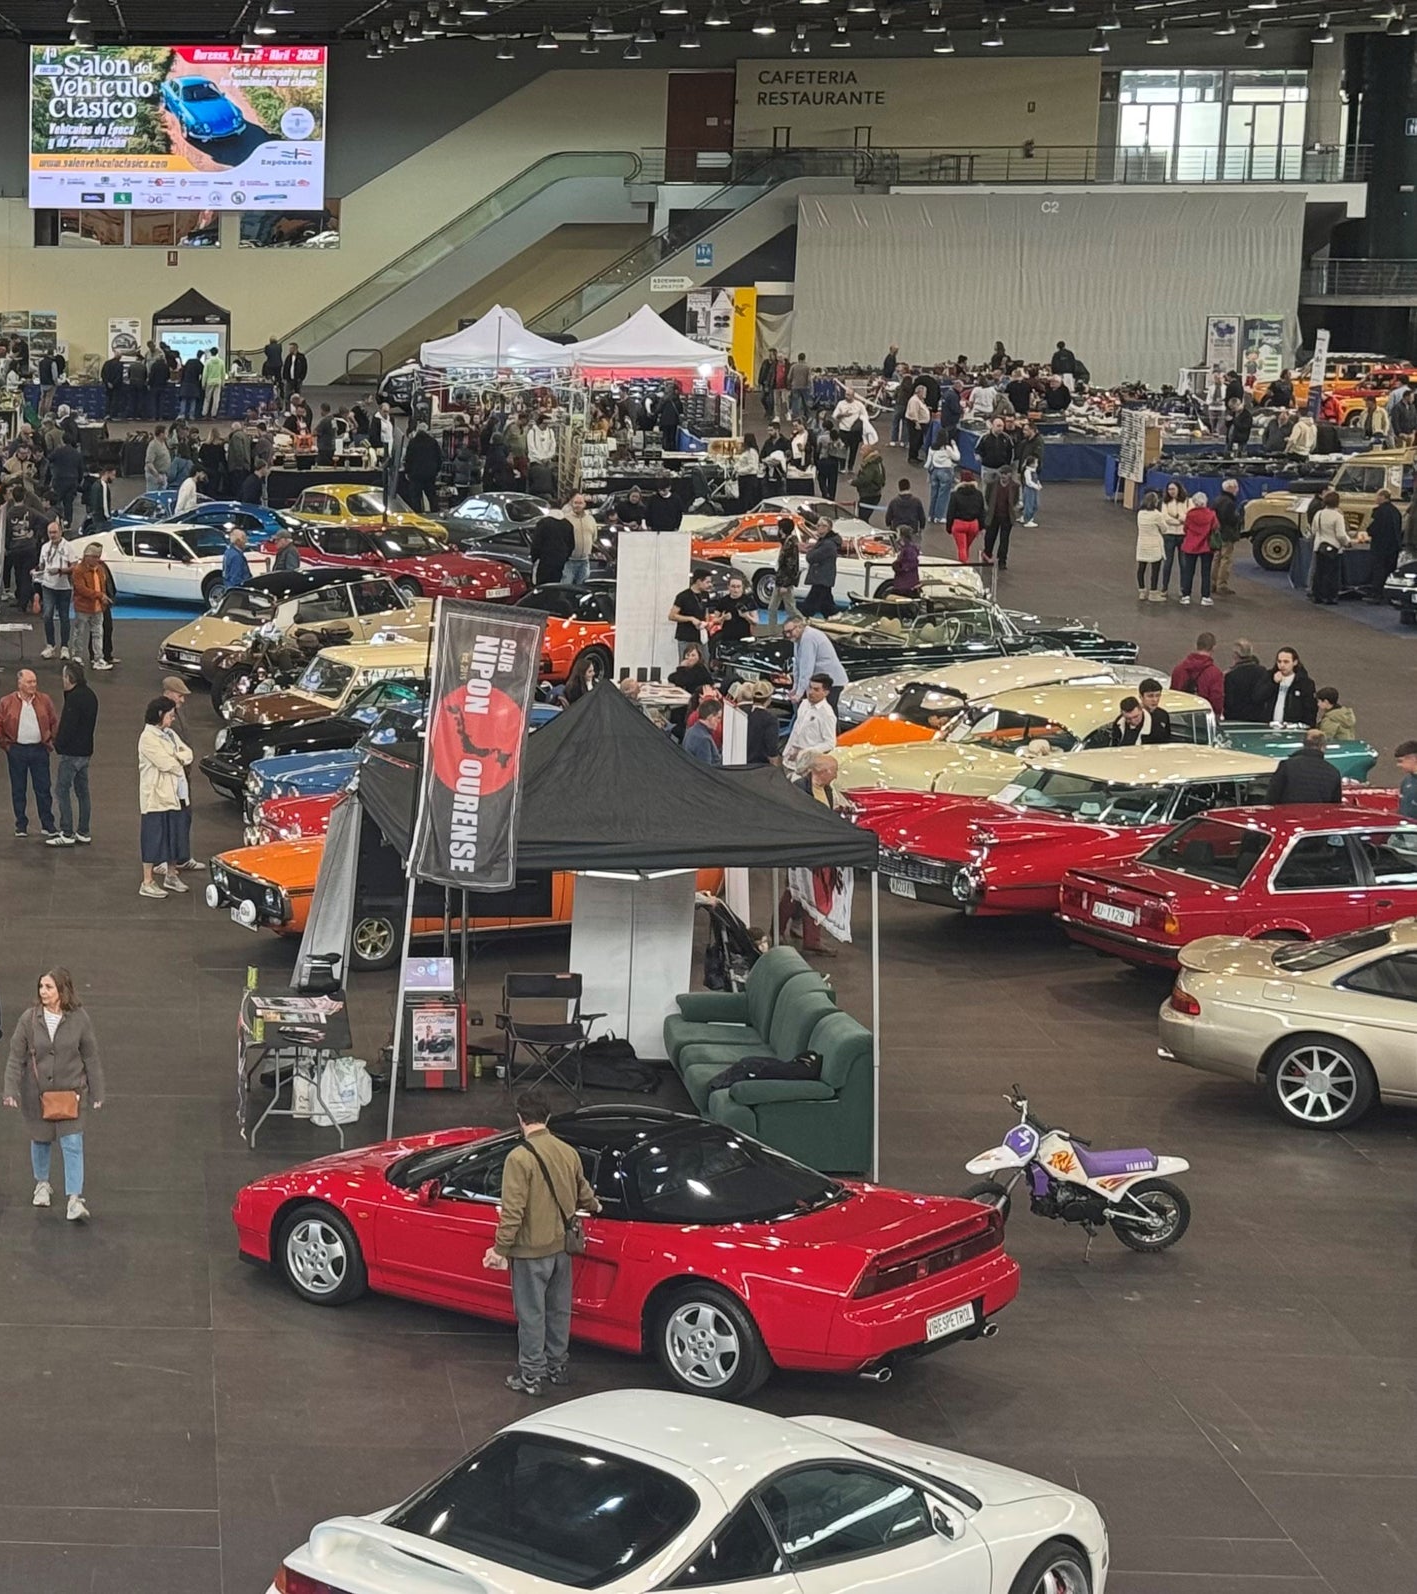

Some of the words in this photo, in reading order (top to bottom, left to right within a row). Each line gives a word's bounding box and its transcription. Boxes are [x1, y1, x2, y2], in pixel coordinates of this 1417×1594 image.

[64, 55, 131, 76] Salón
[134, 62, 152, 74] del
[758, 70, 858, 85] CAFETERIA
[48, 76, 153, 98] Vehículo
[757, 91, 885, 106] RESTAURANTE
[48, 97, 137, 119] Clásico
[49, 123, 92, 135] Vehículos
[94, 123, 105, 135] de
[56, 138, 67, 147] de
[39, 158, 169, 169] www.salonvehiculoclasico.com
[1041, 202, 1060, 214] C2
[497, 639, 518, 673] CLUB
[464, 635, 500, 715] NIPON
[449, 758, 483, 873] OURENSE
[1125, 1160, 1154, 1172] YAMAHA
[927, 1304, 973, 1336] VIBESPETROL
